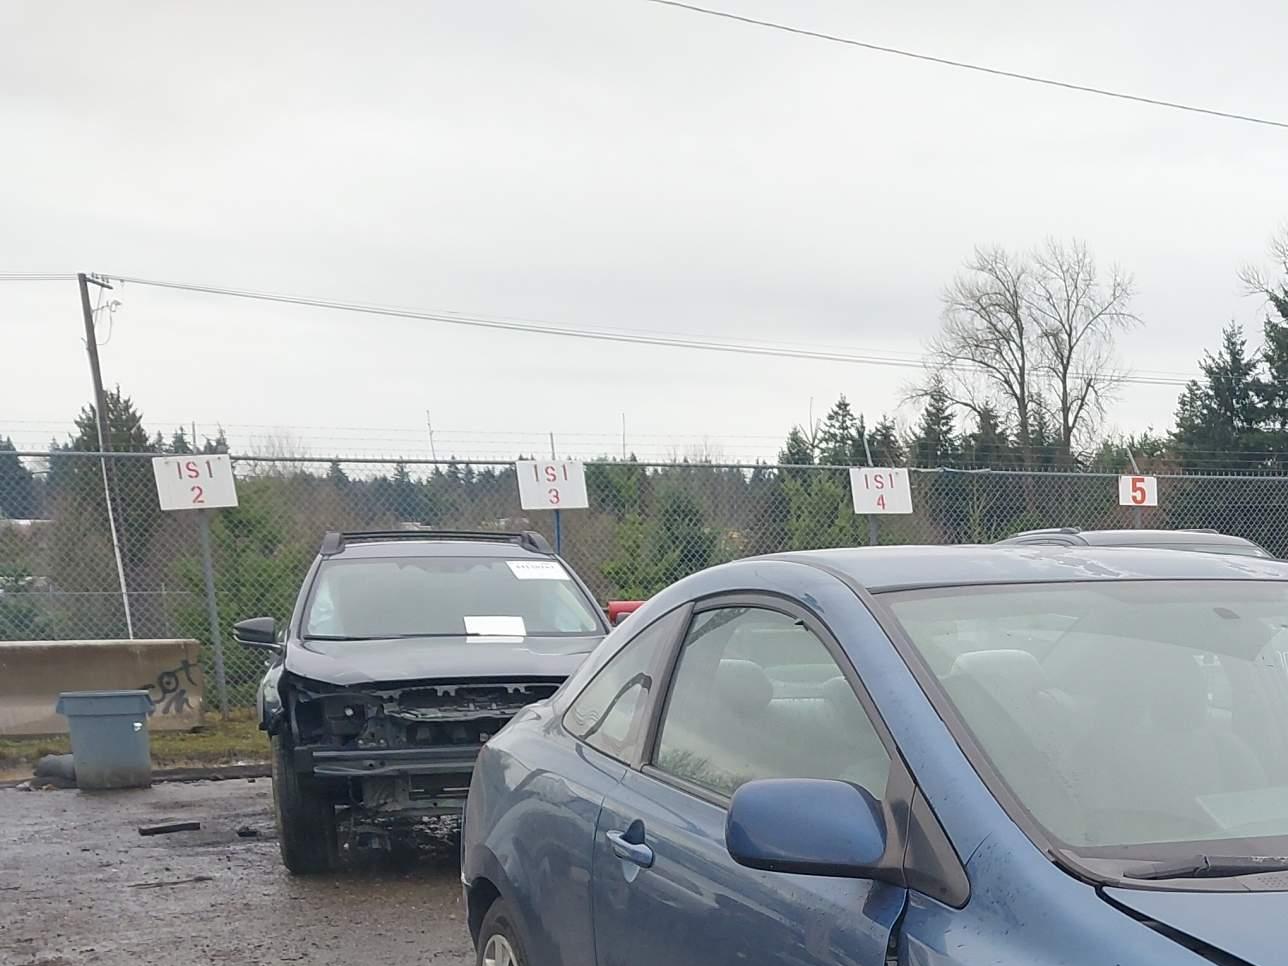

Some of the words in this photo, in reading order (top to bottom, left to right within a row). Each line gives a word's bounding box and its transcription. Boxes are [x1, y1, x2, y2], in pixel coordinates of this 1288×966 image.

[190, 485, 205, 504] 2
[547, 488, 561, 505] 3
[1131, 477, 1146, 505] 5
[876, 493, 887, 511] 4
